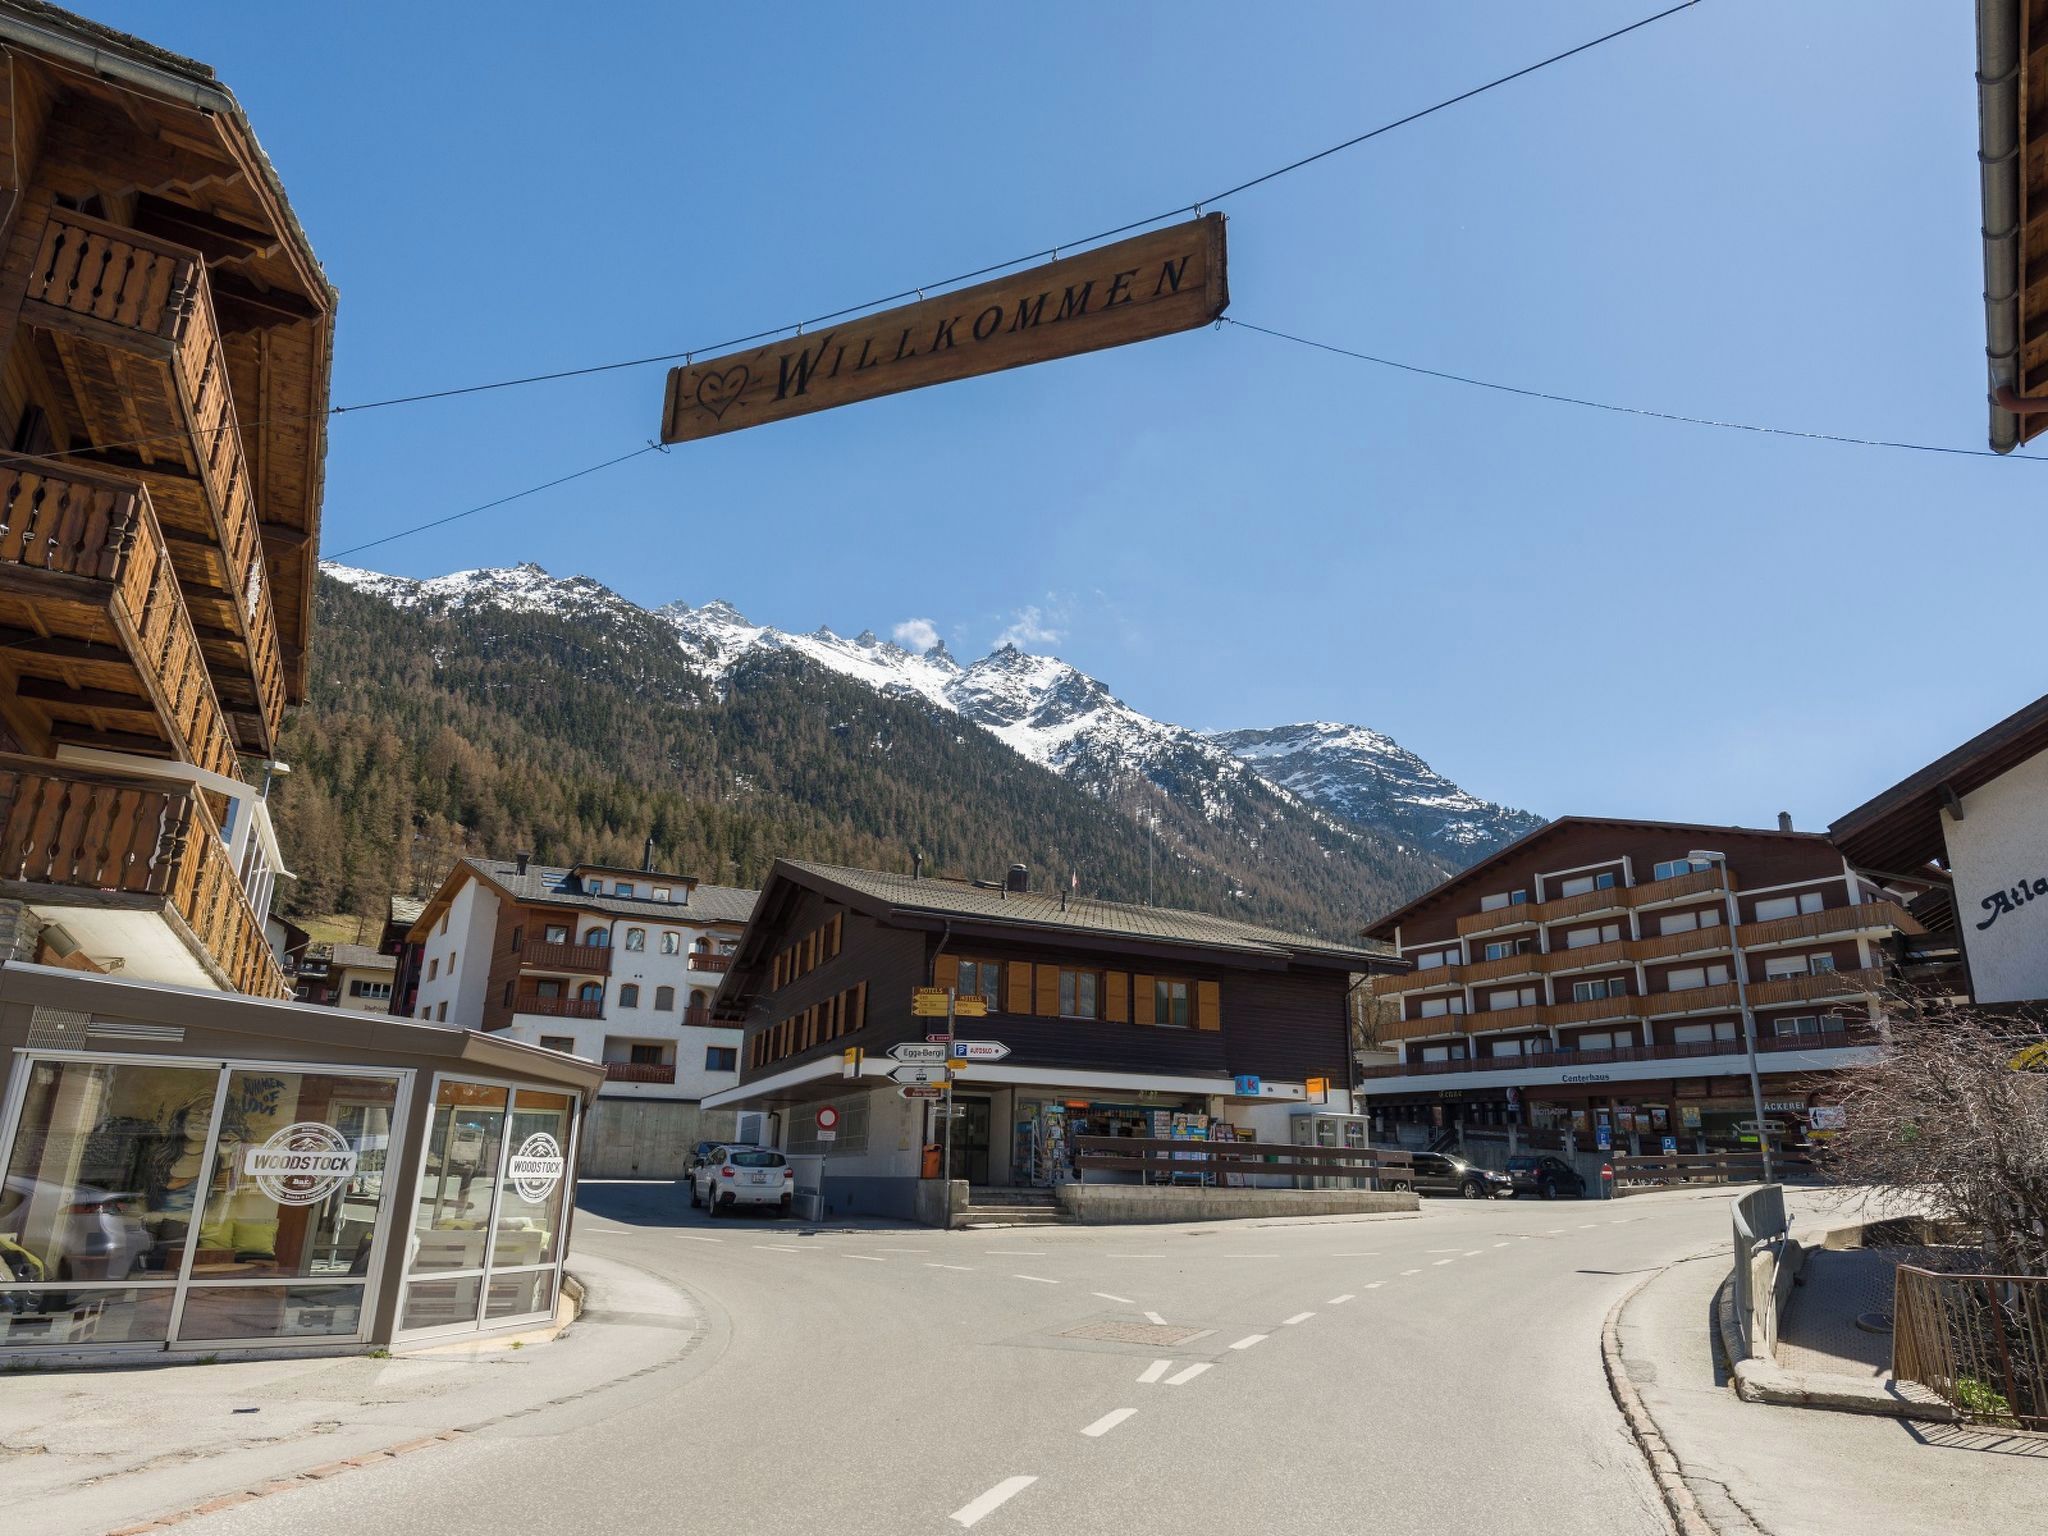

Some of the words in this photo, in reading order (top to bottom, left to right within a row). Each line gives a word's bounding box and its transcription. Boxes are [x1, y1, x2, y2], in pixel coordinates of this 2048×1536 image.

[772, 254, 1192, 402] WILLKOMMEN
[903, 1046, 944, 1058] Egga-Bergli
[1562, 1073, 1610, 1084] Centerhaus
[1763, 1101, 1805, 1111] ÄCKEREI
[254, 1154, 352, 1171] WOODSTOCK
[513, 1160, 562, 1174] WOODSTOCK
